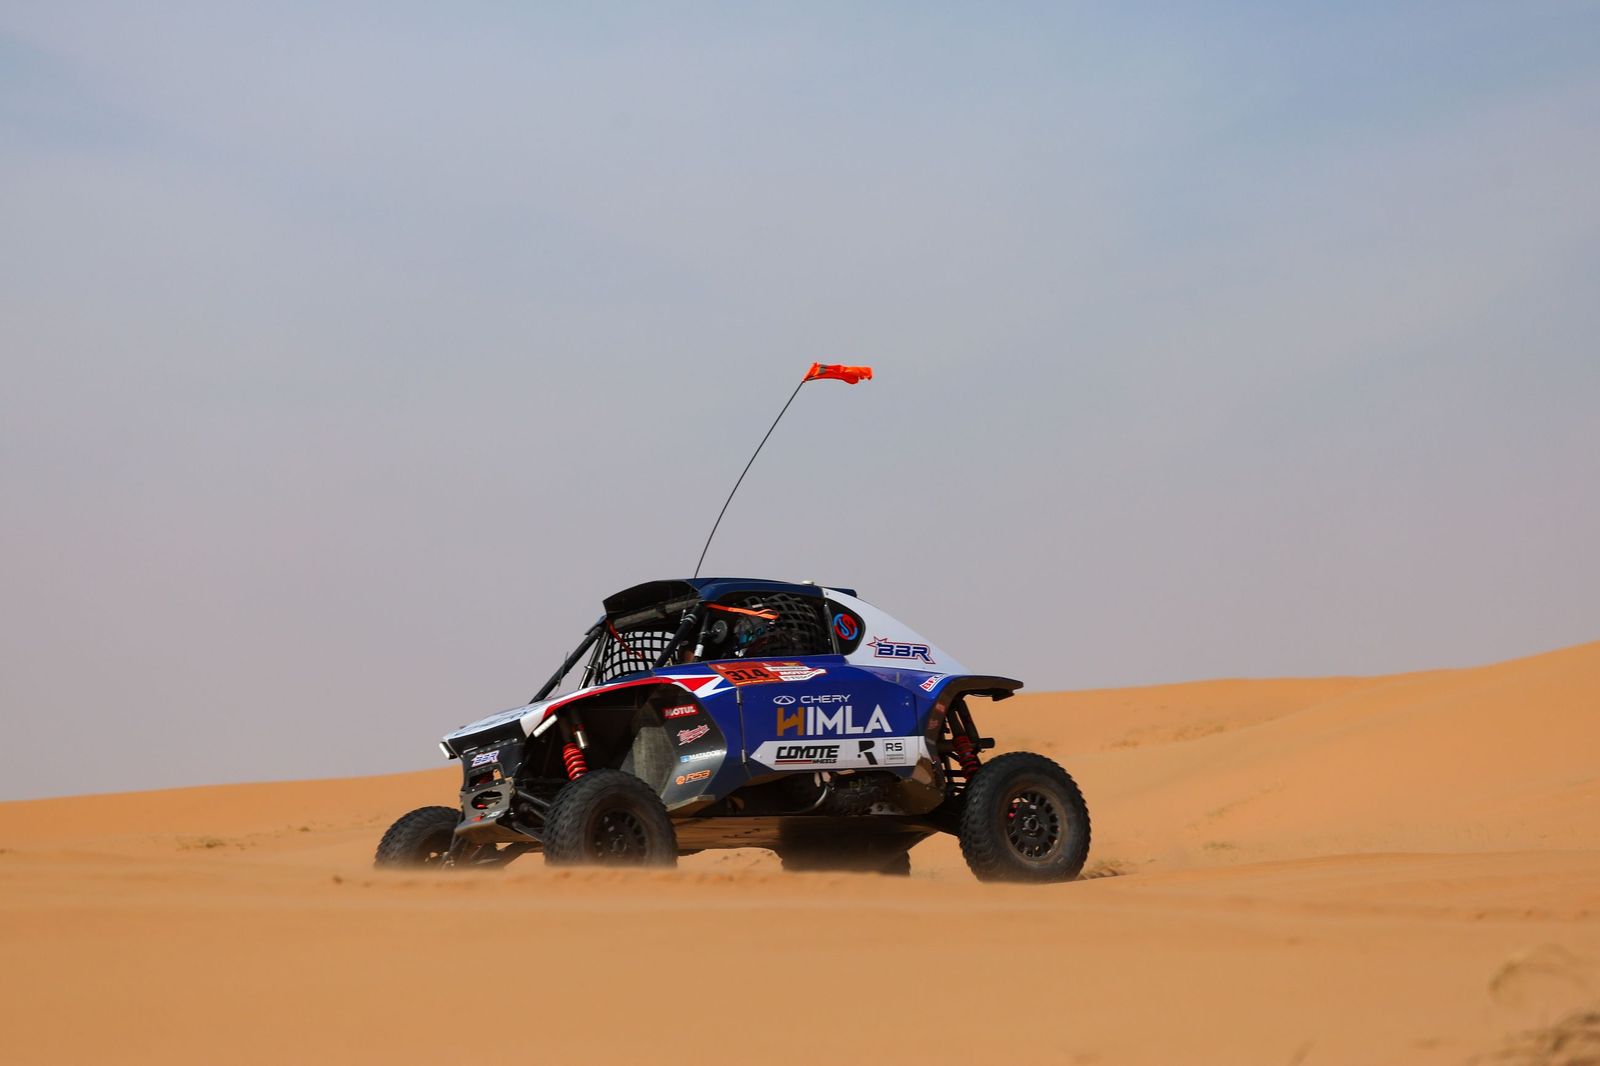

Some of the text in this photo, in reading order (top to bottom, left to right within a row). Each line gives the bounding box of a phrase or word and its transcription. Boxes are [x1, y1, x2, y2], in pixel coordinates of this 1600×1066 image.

[874, 640, 933, 662] BBR
[724, 668, 769, 681] 314
[800, 694, 851, 704] CHERY
[664, 706, 697, 717] MOTUL
[776, 704, 893, 737] HIMLA
[776, 745, 840, 759] COYOTE
[885, 742, 903, 752] RS
